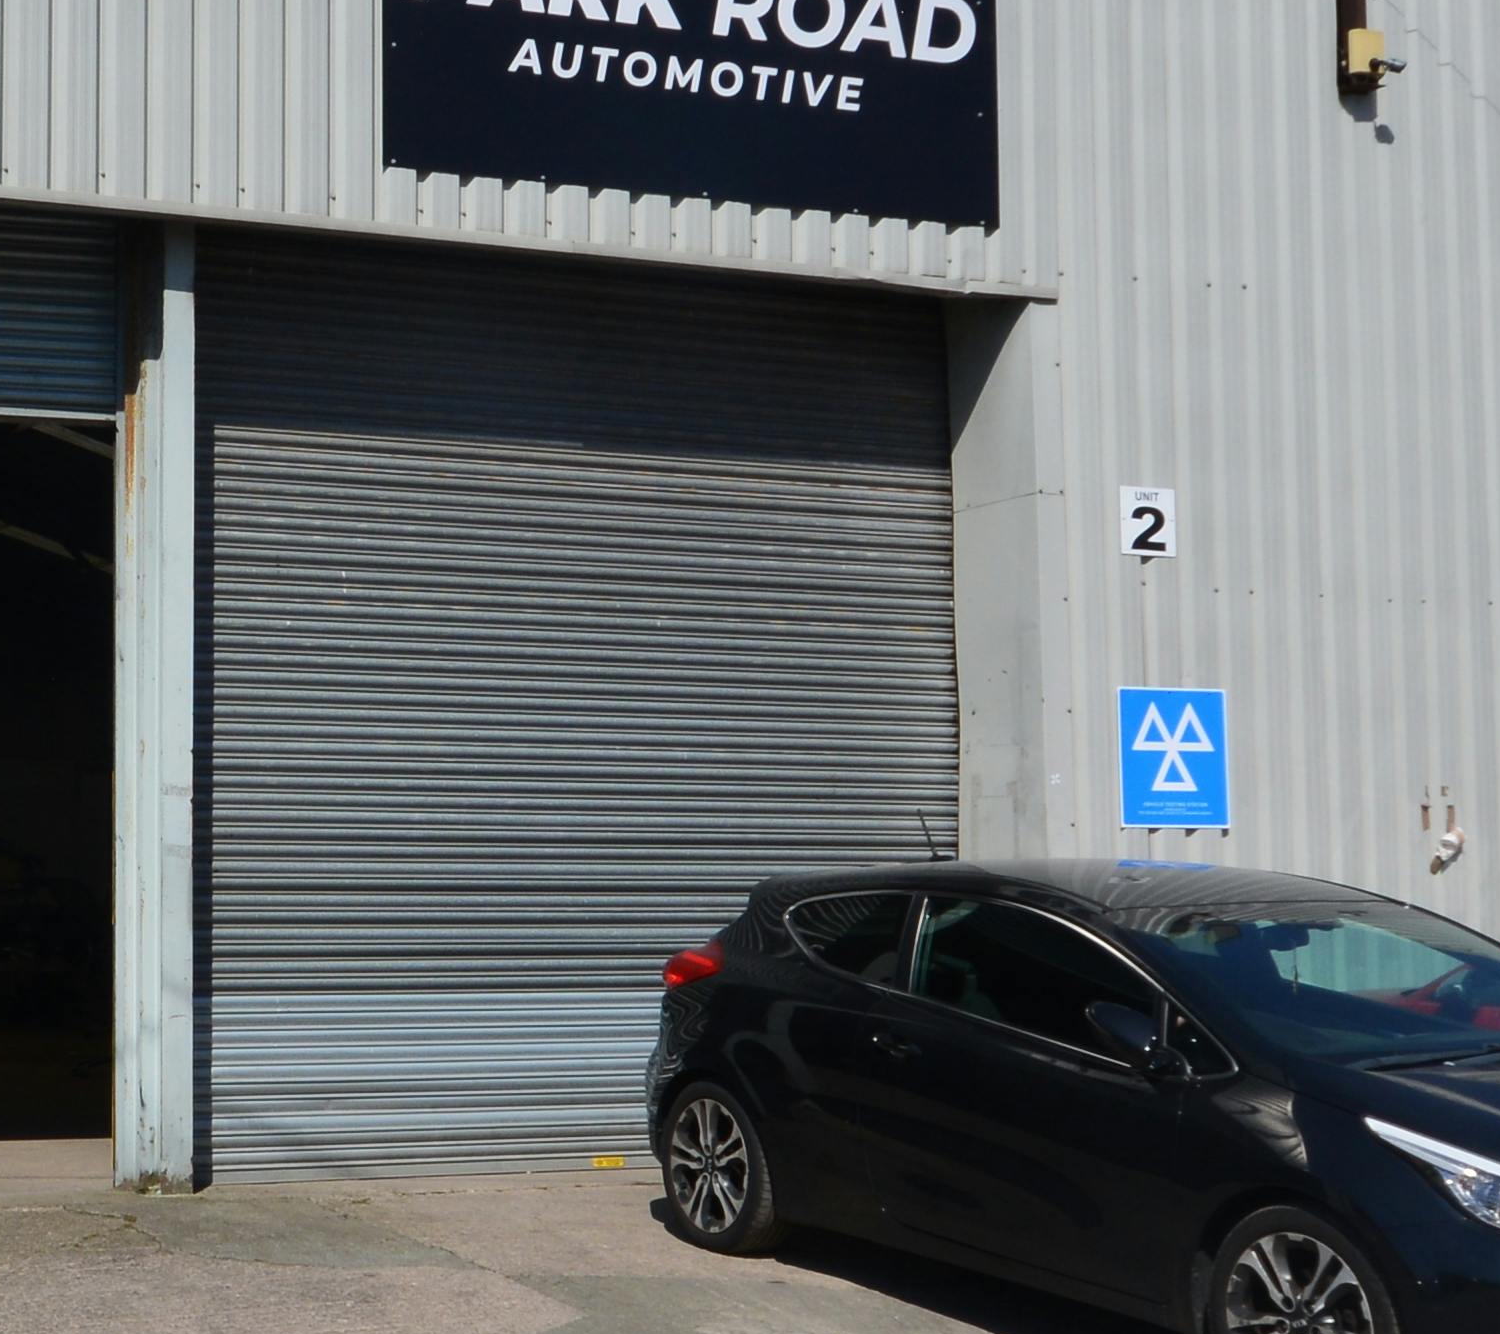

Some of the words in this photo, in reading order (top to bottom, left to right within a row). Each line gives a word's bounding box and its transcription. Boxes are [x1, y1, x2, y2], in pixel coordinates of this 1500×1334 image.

[507, 38, 864, 112] AUTOMOTIVE
[1134, 491, 1160, 502] UNIT
[1131, 505, 1167, 552] 2
